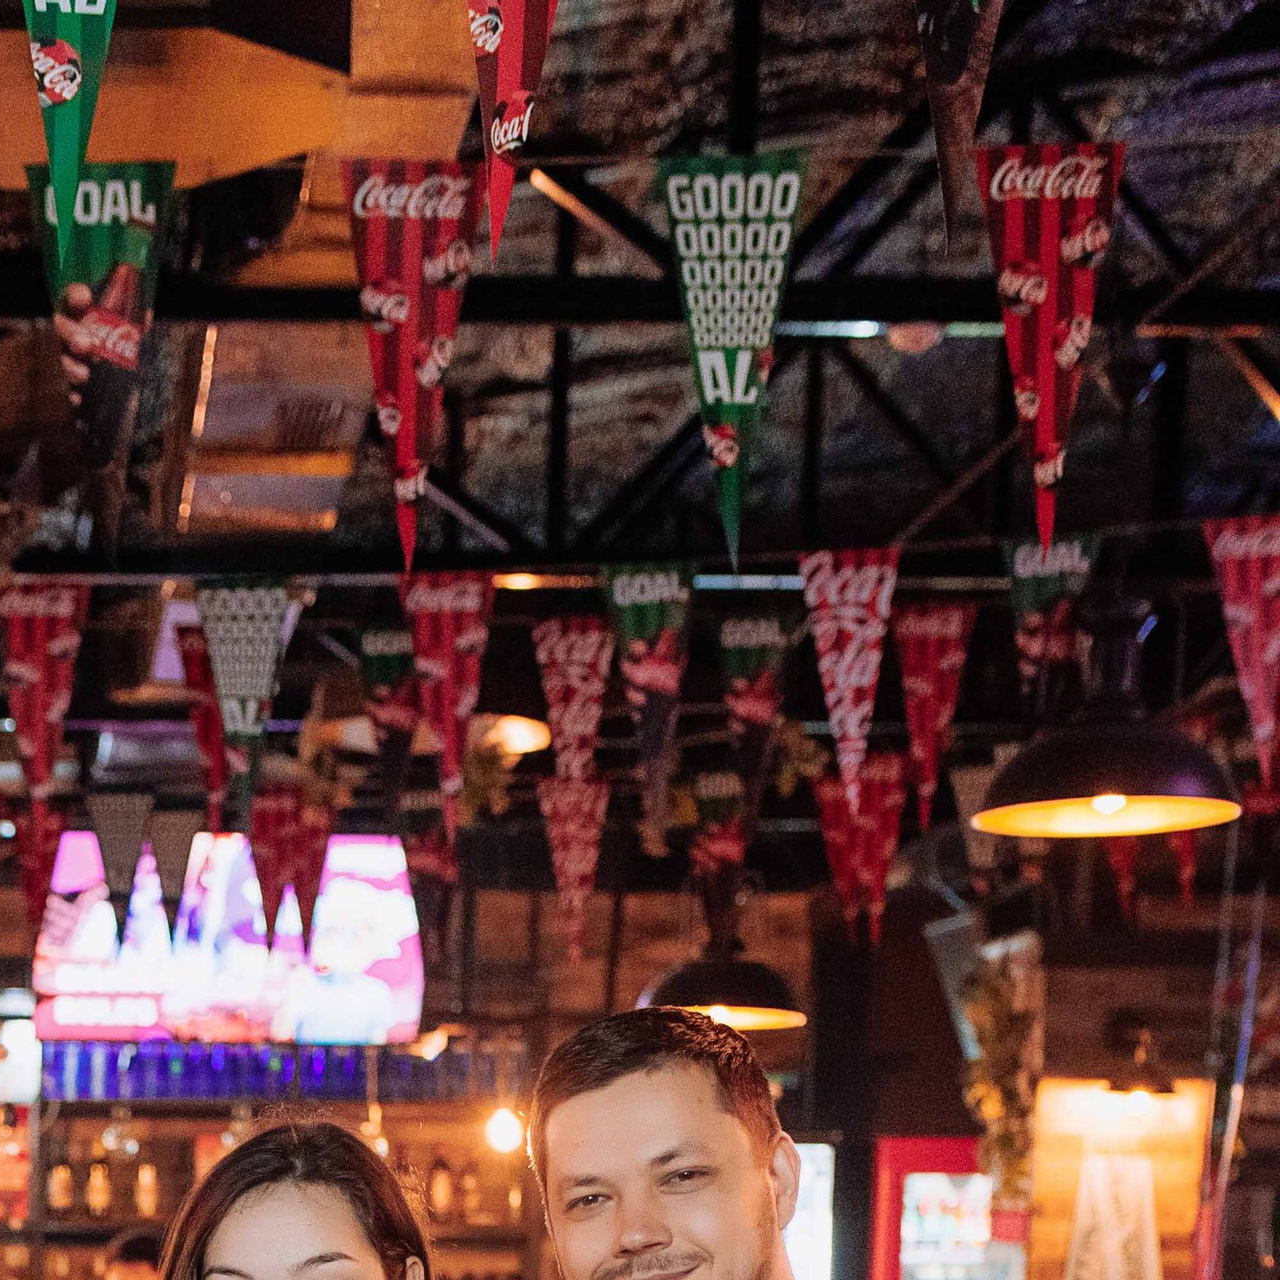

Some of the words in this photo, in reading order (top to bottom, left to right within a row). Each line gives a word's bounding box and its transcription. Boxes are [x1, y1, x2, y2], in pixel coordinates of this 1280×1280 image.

[668, 172, 801, 220] GOOOO
[674, 221, 792, 259] OOOOO
[698, 350, 758, 404] AL
